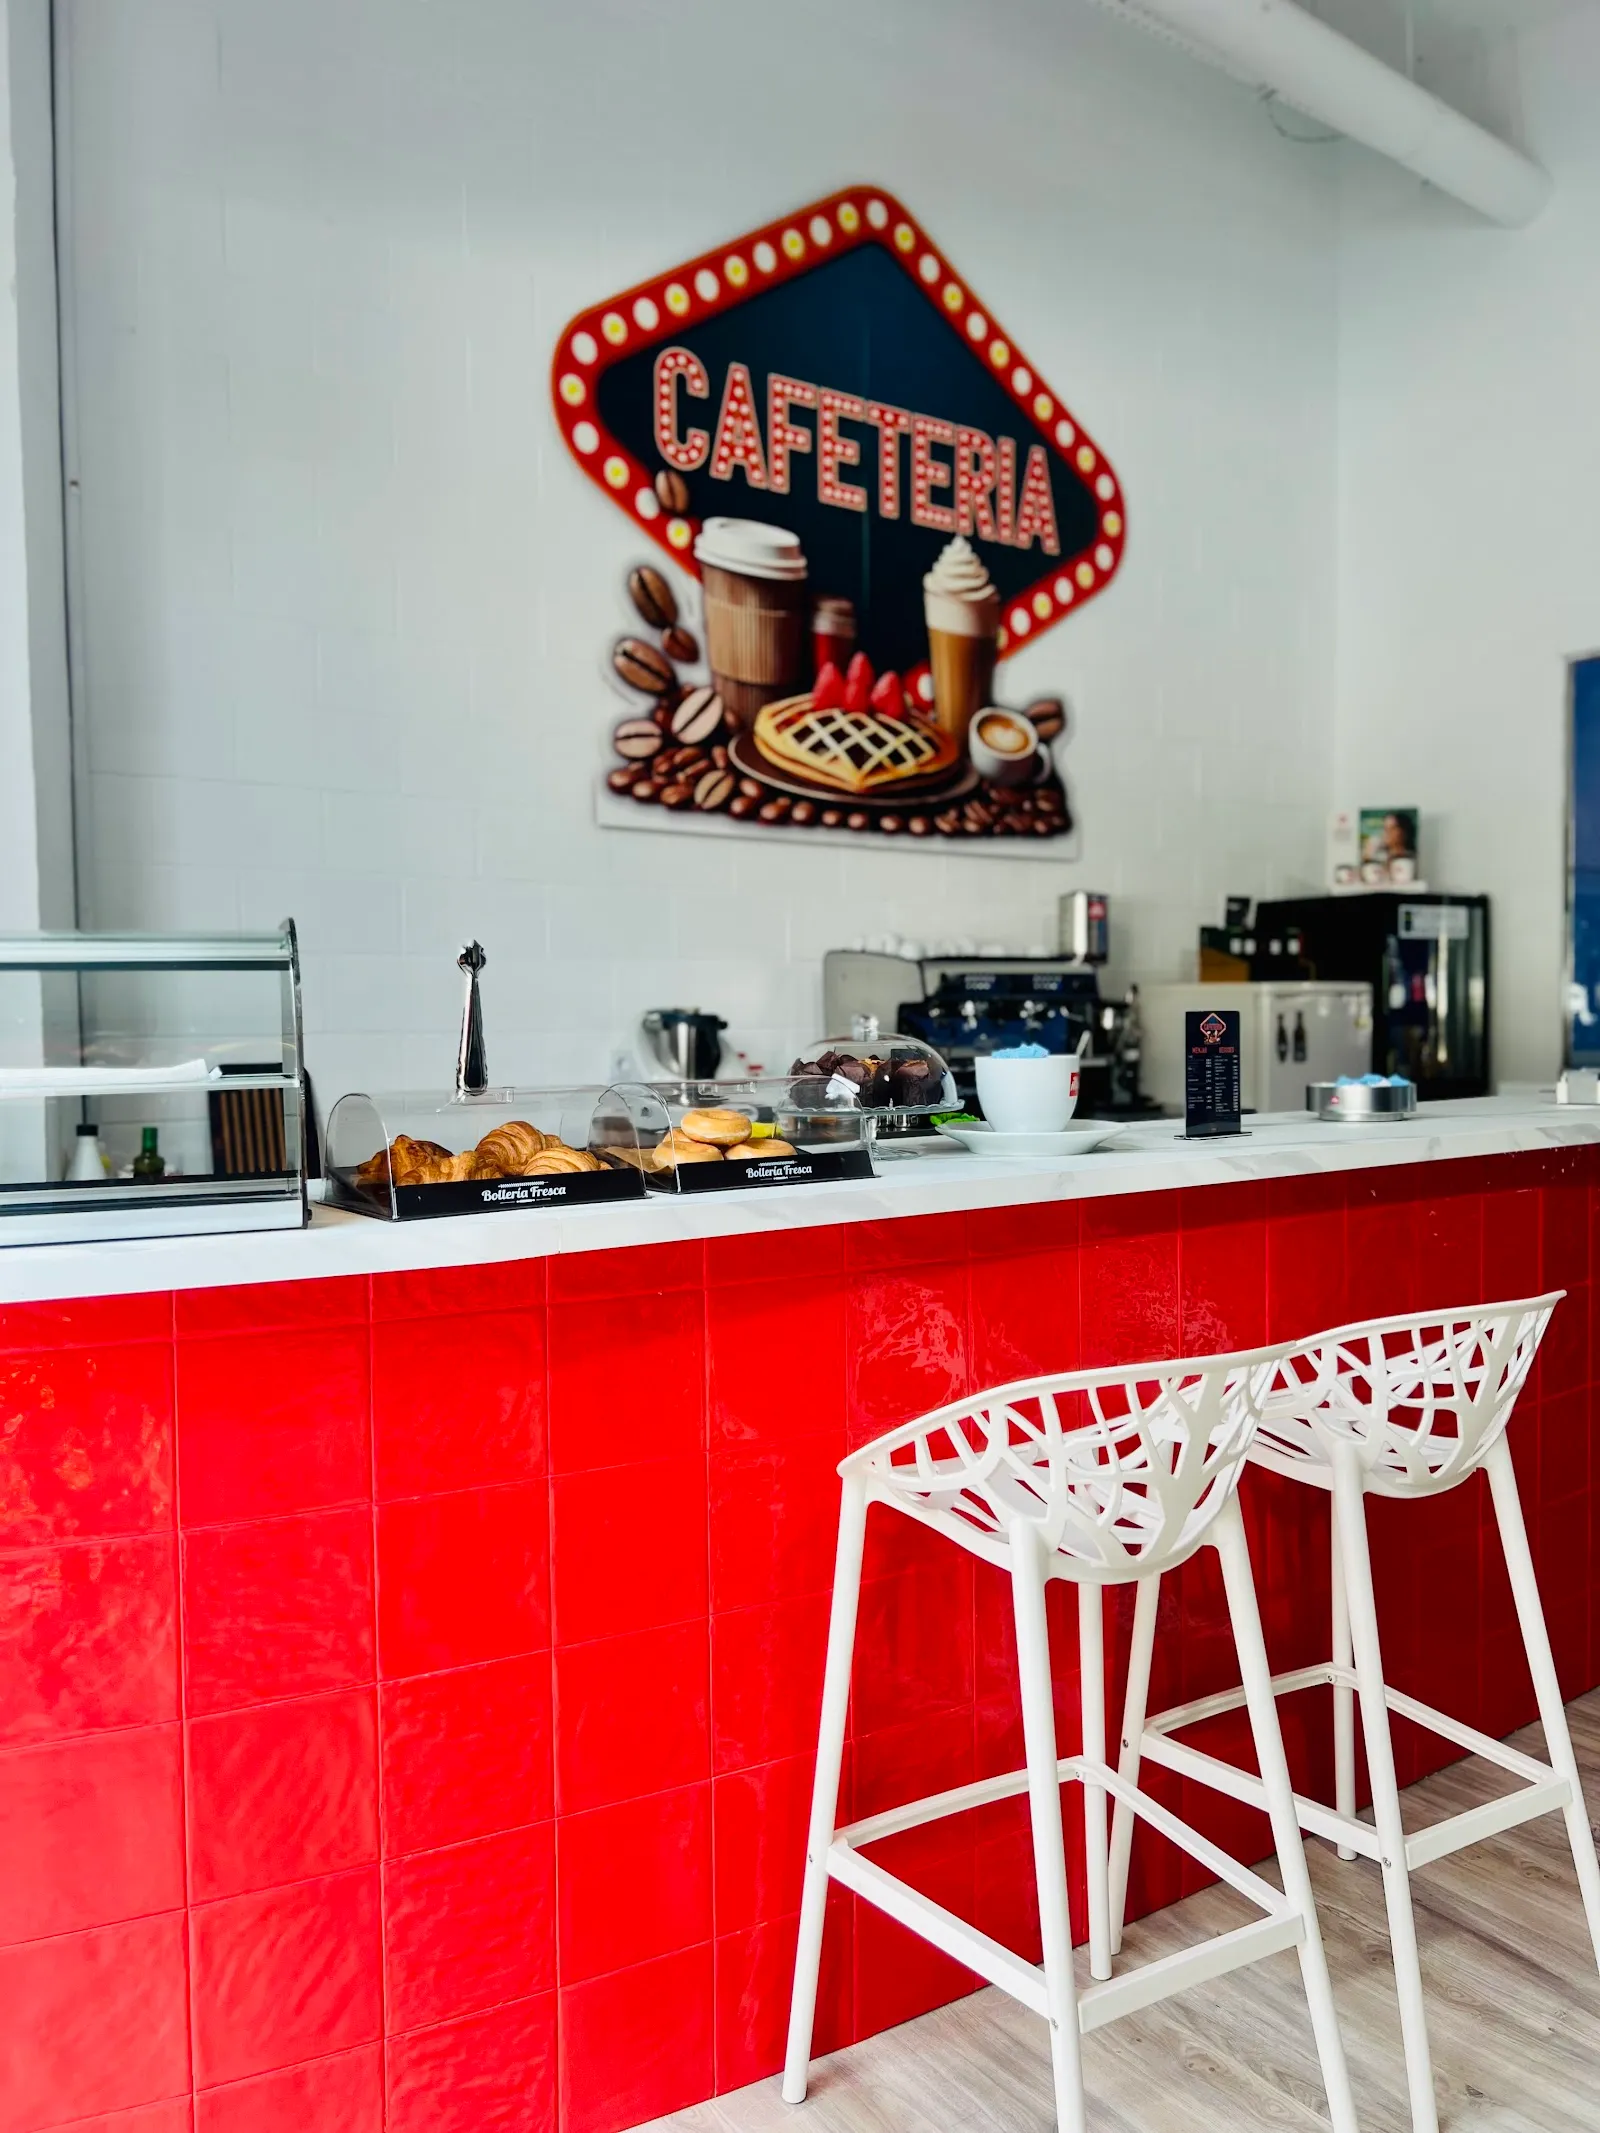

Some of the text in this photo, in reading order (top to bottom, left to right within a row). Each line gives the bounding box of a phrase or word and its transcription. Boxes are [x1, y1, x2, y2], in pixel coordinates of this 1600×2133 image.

[653, 346, 1060, 556] CAFETERIA
[745, 1164, 813, 1179] Bollería Fresca
[481, 1186, 567, 1202] Bollería Fresca
